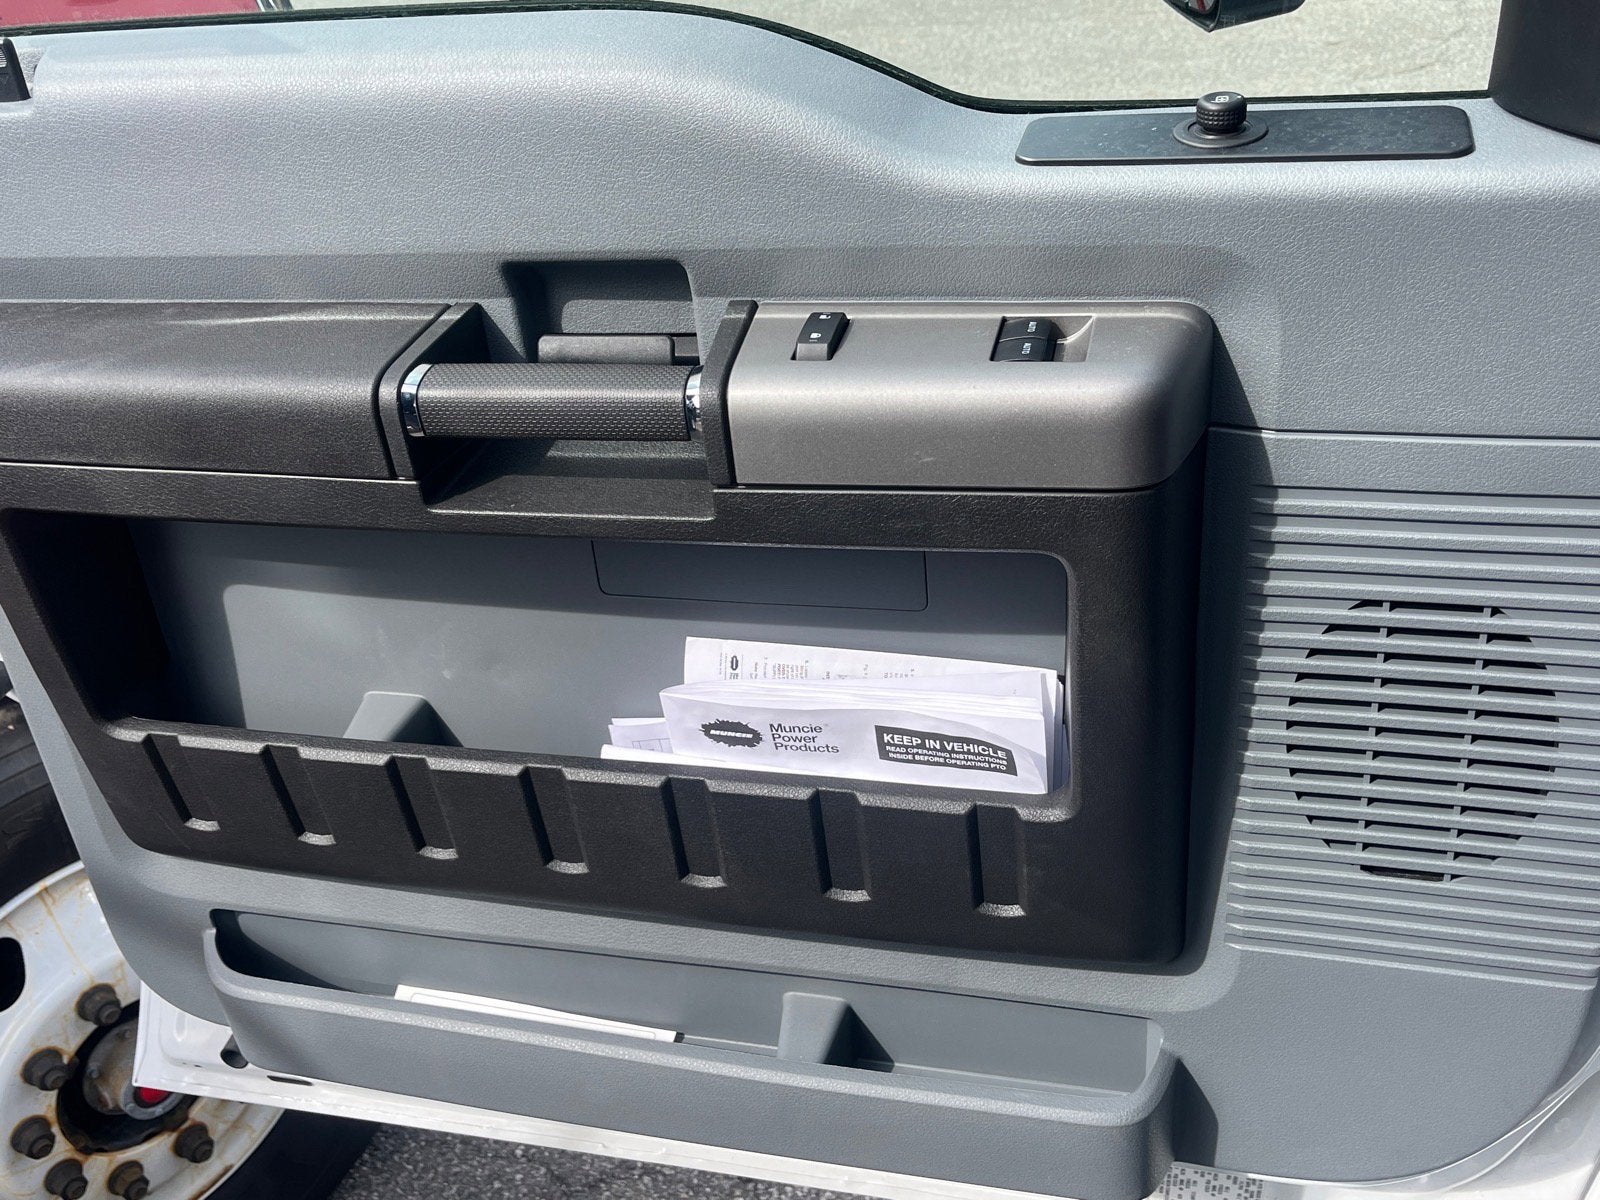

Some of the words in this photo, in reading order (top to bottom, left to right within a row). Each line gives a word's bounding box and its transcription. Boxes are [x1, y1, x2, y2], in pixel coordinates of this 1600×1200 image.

[769, 723, 823, 734] Muncie
[772, 733, 818, 743] Power
[774, 742, 840, 753] Products
[883, 733, 921, 746] KEEP
[925, 739, 941, 749] IN
[944, 741, 1007, 759] VEHICLE
[888, 752, 914, 760] INSIDE
[915, 755, 945, 763] BEFORE
[945, 758, 989, 768] OPERATING
[907, 747, 950, 758] OPERATING
[951, 753, 1008, 765] INSTRUCTIONS
